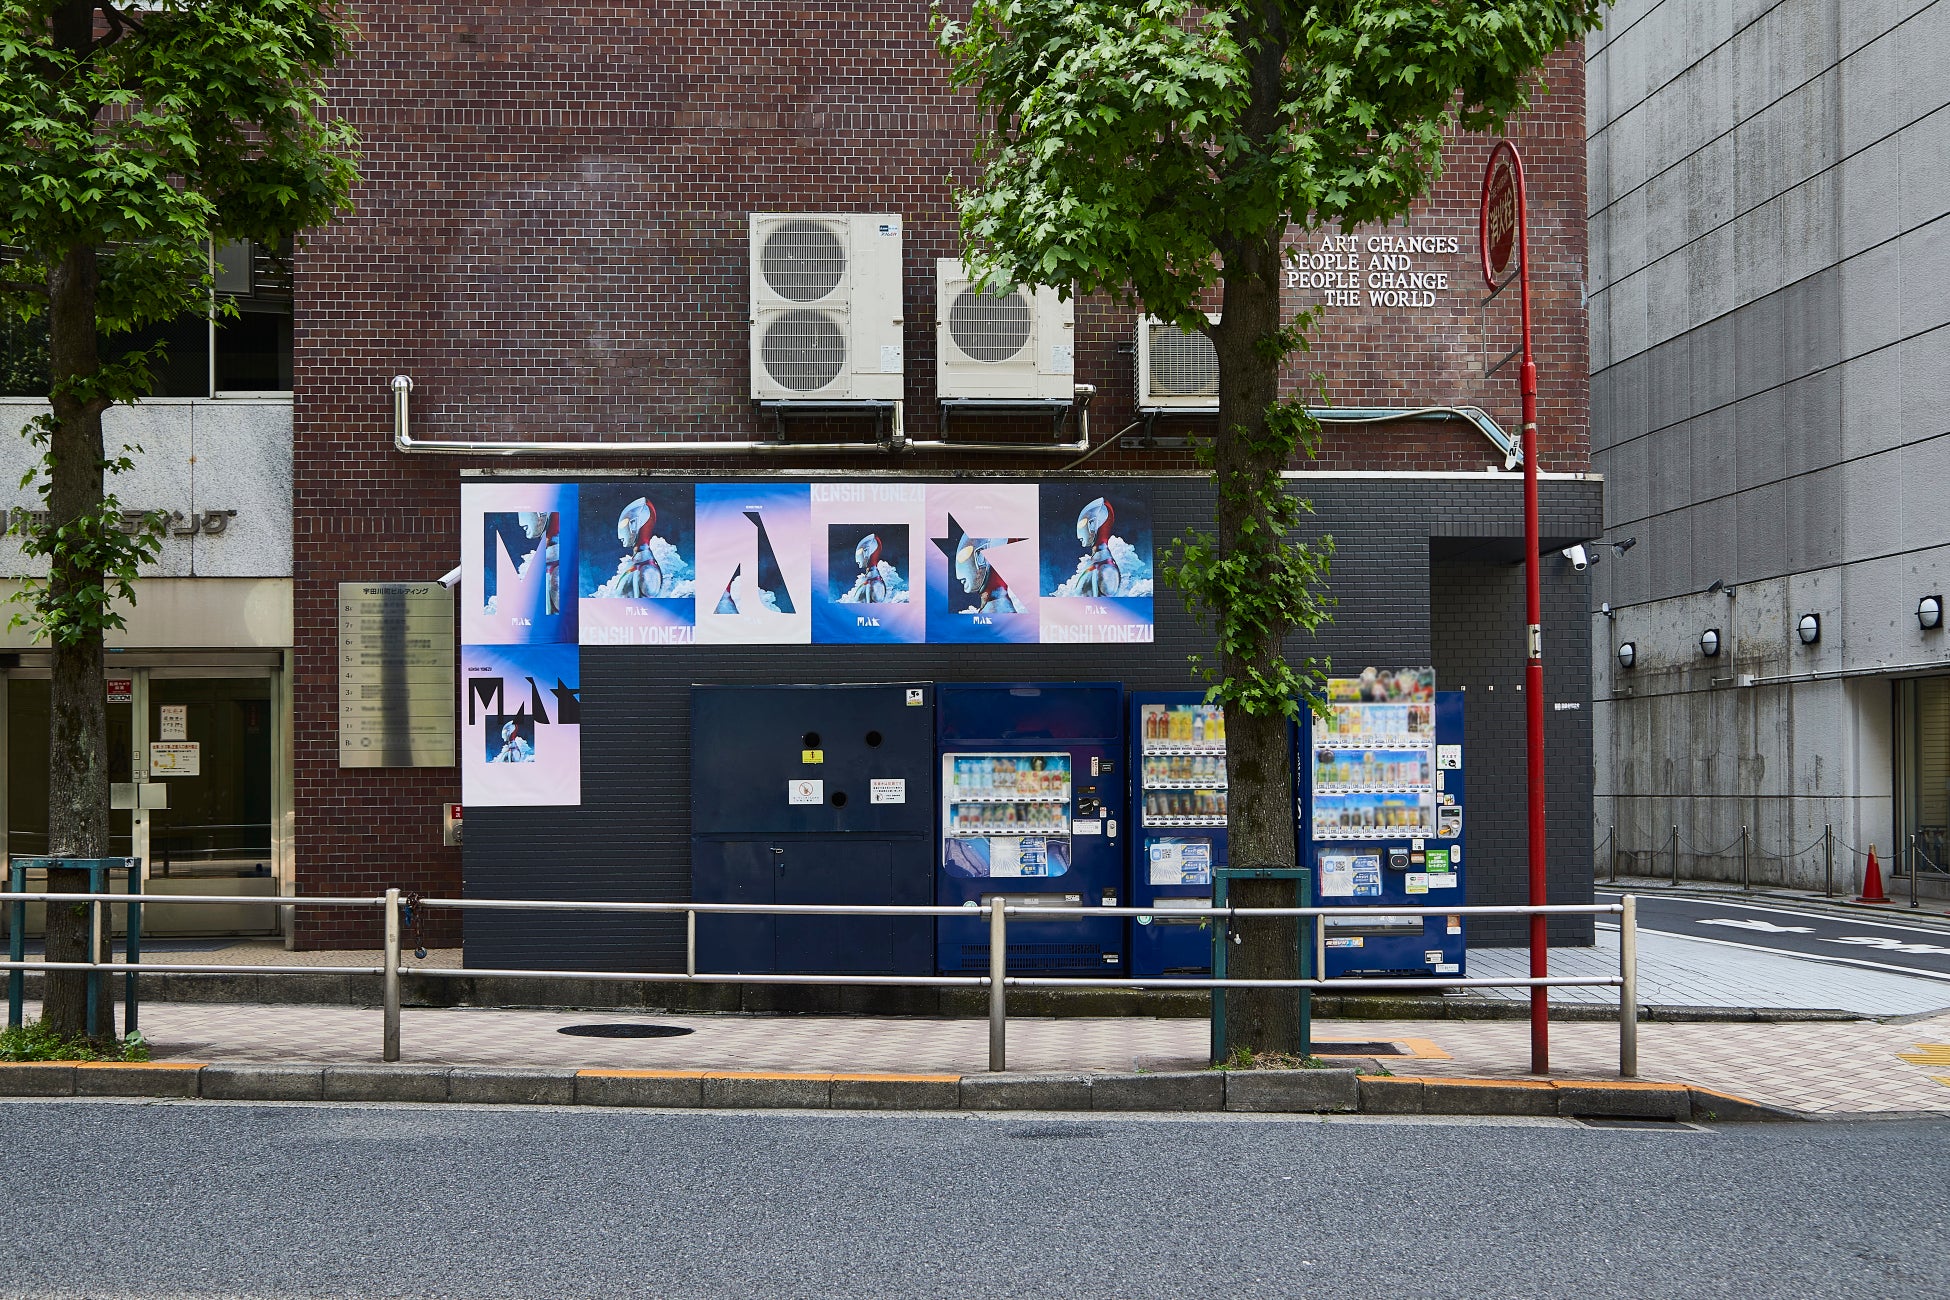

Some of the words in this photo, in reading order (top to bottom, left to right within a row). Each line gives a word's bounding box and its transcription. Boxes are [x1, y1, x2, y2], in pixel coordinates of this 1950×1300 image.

[1320, 235, 1359, 252] ART
[1367, 236, 1458, 253] CHANGES
[1368, 254, 1411, 271] AND
[1287, 272, 1360, 288] PEOPLE
[1368, 272, 1448, 290] CHANGE
[1325, 290, 1361, 307] THE
[1368, 290, 1436, 307] WORLD
[812, 484, 865, 502] KENSHI
[581, 625, 634, 644] KENSHI
[638, 625, 696, 643] YONEZU
[1040, 624, 1093, 642] KENSHI
[1098, 624, 1154, 642] YONEZU
